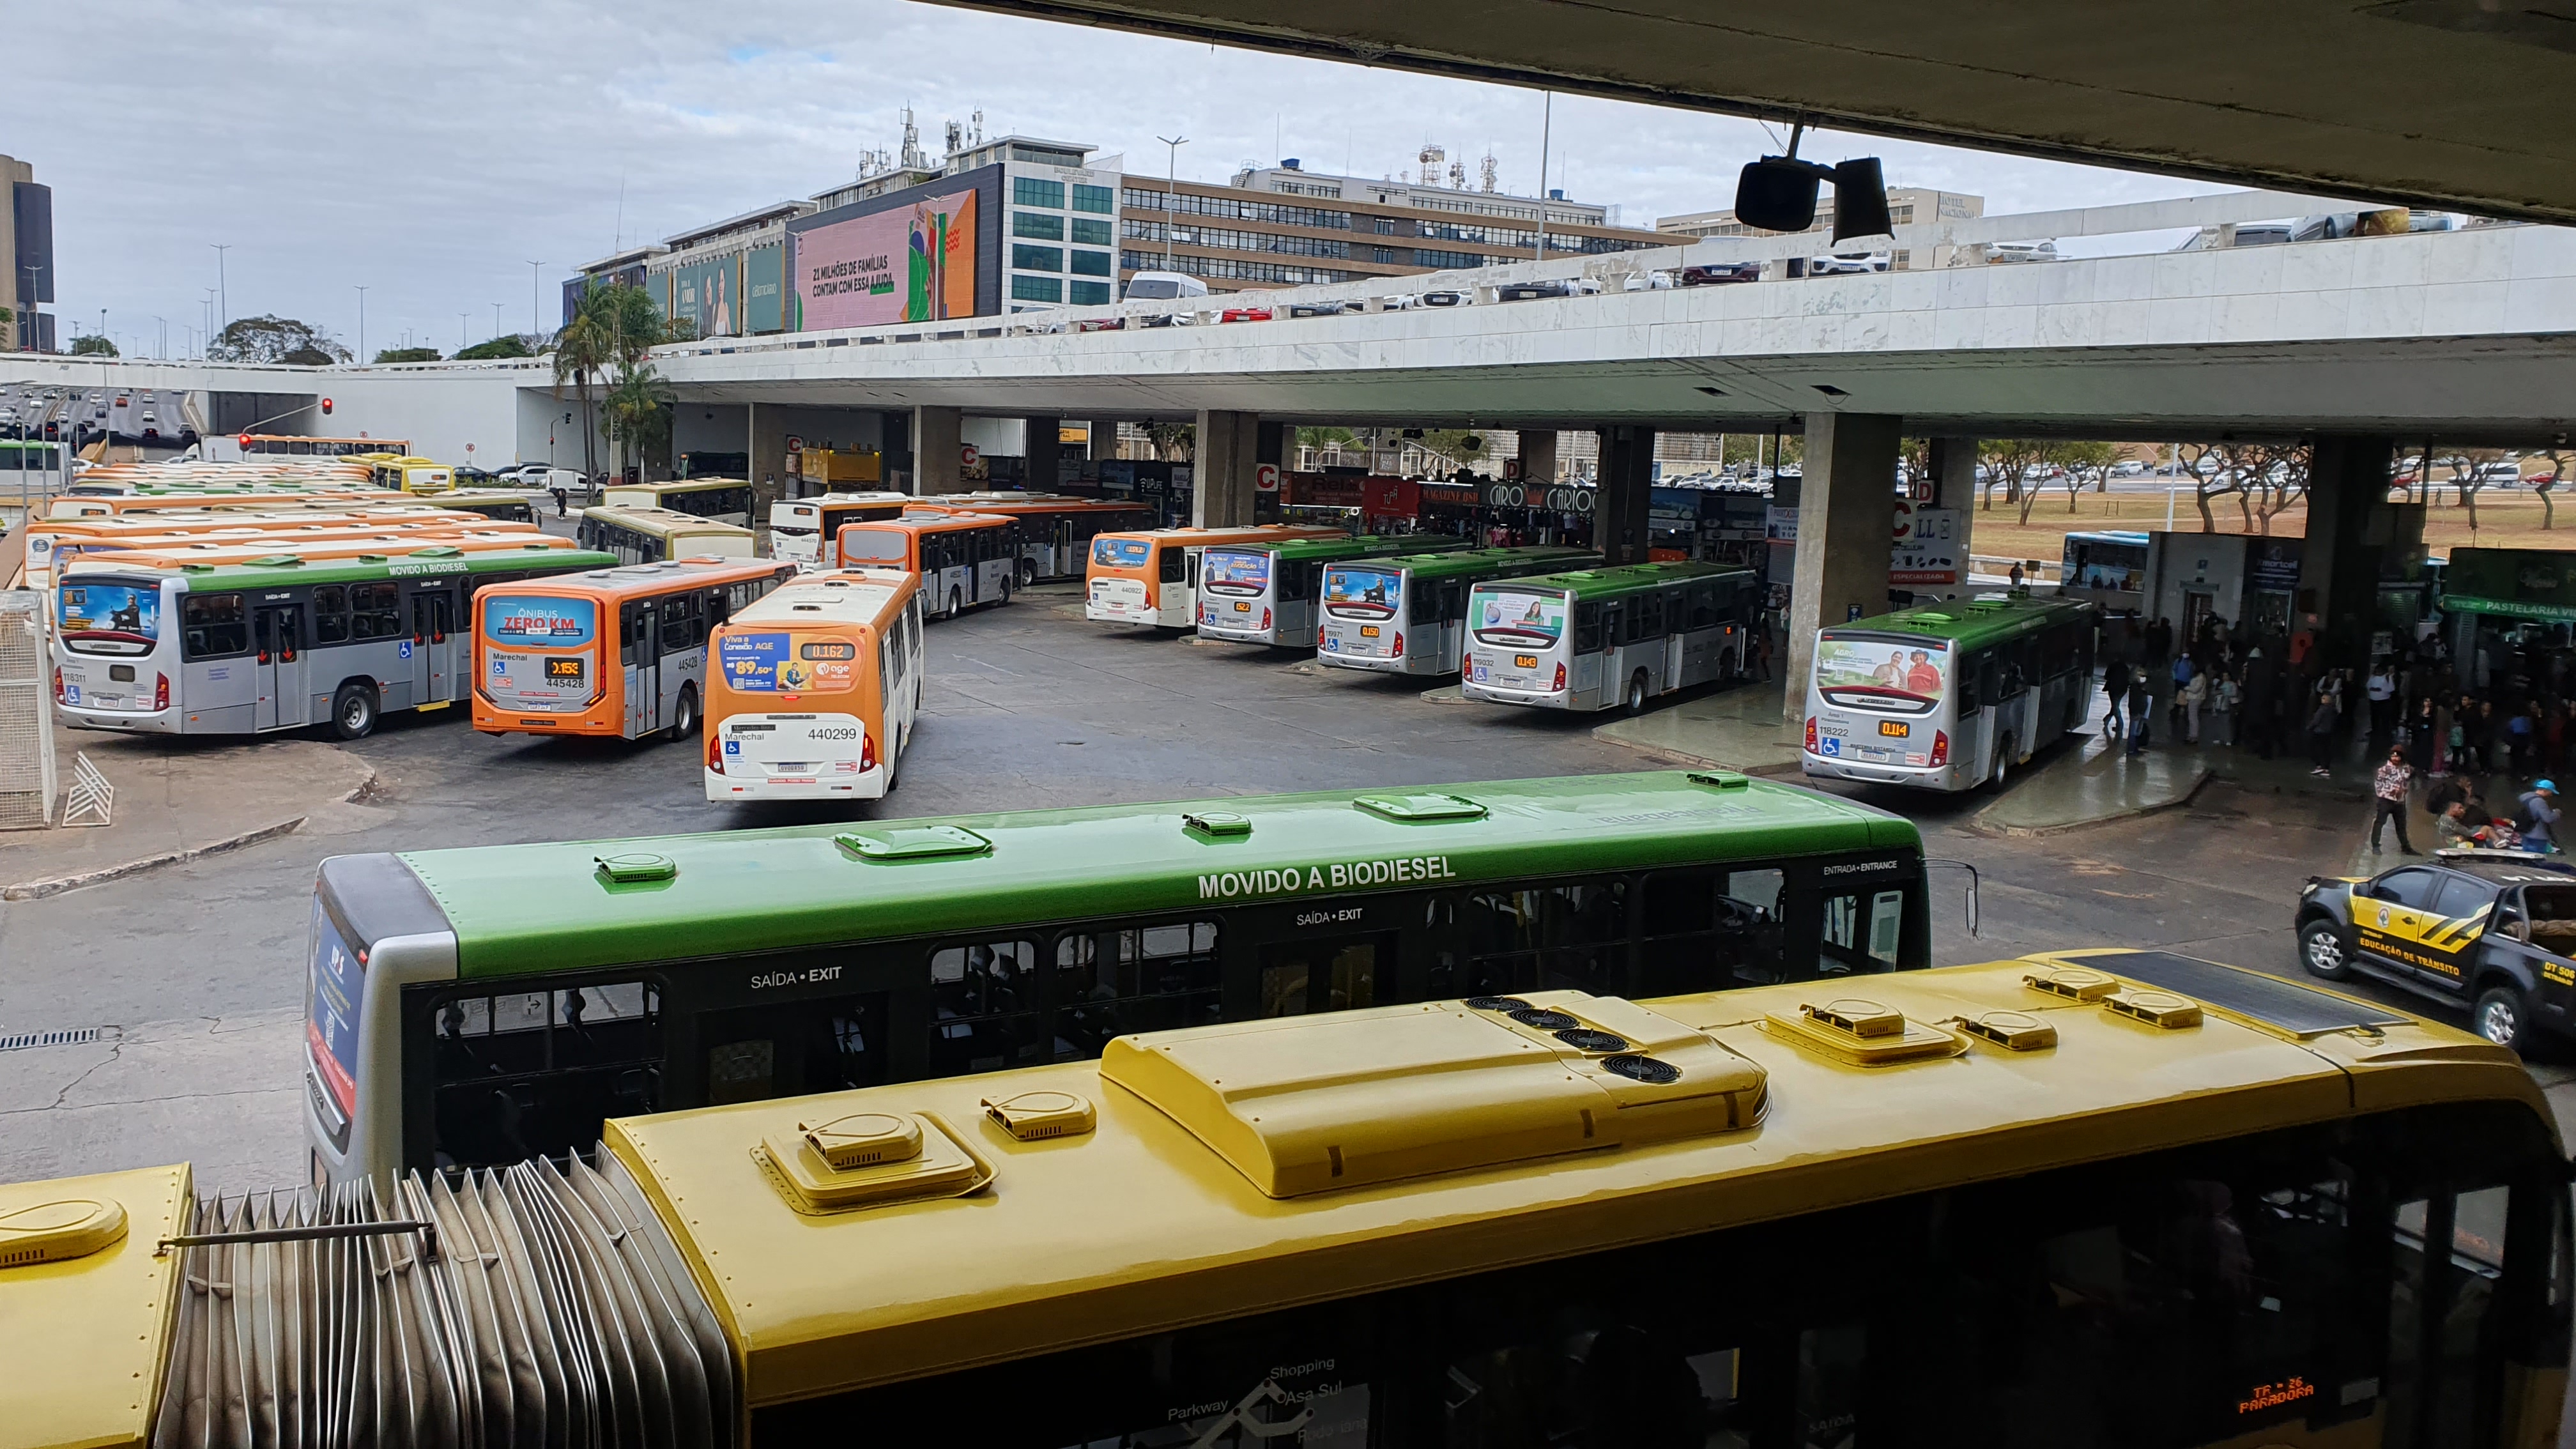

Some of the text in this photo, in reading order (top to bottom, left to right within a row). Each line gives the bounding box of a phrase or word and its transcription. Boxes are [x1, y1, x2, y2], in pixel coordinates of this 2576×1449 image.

[1054, 166, 1094, 177] BOULEVARD
[1061, 175, 1087, 183] CENTER
[1940, 195, 1965, 208] HOTEL
[813, 254, 887, 281] 21 MILHÕES DE FAMÍLIAS
[813, 280, 838, 298] CONTAM
[839, 279, 853, 294] COM
[854, 275, 870, 292] ESSA
[788, 438, 801, 452] C
[1257, 466, 1275, 488] C
[1422, 488, 1478, 502] MAGAZINE BSB
[1489, 484, 1523, 507] GIRO
[1919, 482, 1932, 502] D
[1892, 502, 1912, 537] C
[388, 562, 469, 576] MOVIDO A BIODIESEL
[518, 608, 558, 618] ÔNIBUS
[2486, 601, 2558, 615] PASTELARIA
[504, 617, 574, 629] ZERO KM
[1363, 627, 1379, 636] 0.150
[724, 642, 753, 650] Conexão
[812, 645, 843, 657] 0.162
[493, 653, 527, 661] Marechal
[678, 656, 698, 672] 445428
[1517, 656, 1537, 667] 0.143
[831, 664, 850, 674] age
[63, 673, 86, 682] 118311
[546, 678, 585, 688] 445428
[808, 728, 857, 740] 440299
[1820, 726, 1848, 737] 118222
[1882, 723, 1907, 736] 0.114
[1823, 861, 1897, 875] ENTRADA ENTRANCE
[1198, 856, 1456, 899] MOVIDO A BIODIESEL
[1296, 908, 1363, 926] SAÍDA EXIT
[2360, 937, 2460, 976] EDUCAÇÃO DE TRÂNSITO
[751, 966, 842, 988] SAÍDA EXIT
[2544, 962, 2575, 979] DT 506
[1269, 1358, 1335, 1380] Shopping
[1285, 1380, 1342, 1406] Asa Sul
[1168, 1400, 1229, 1422] Parkway
